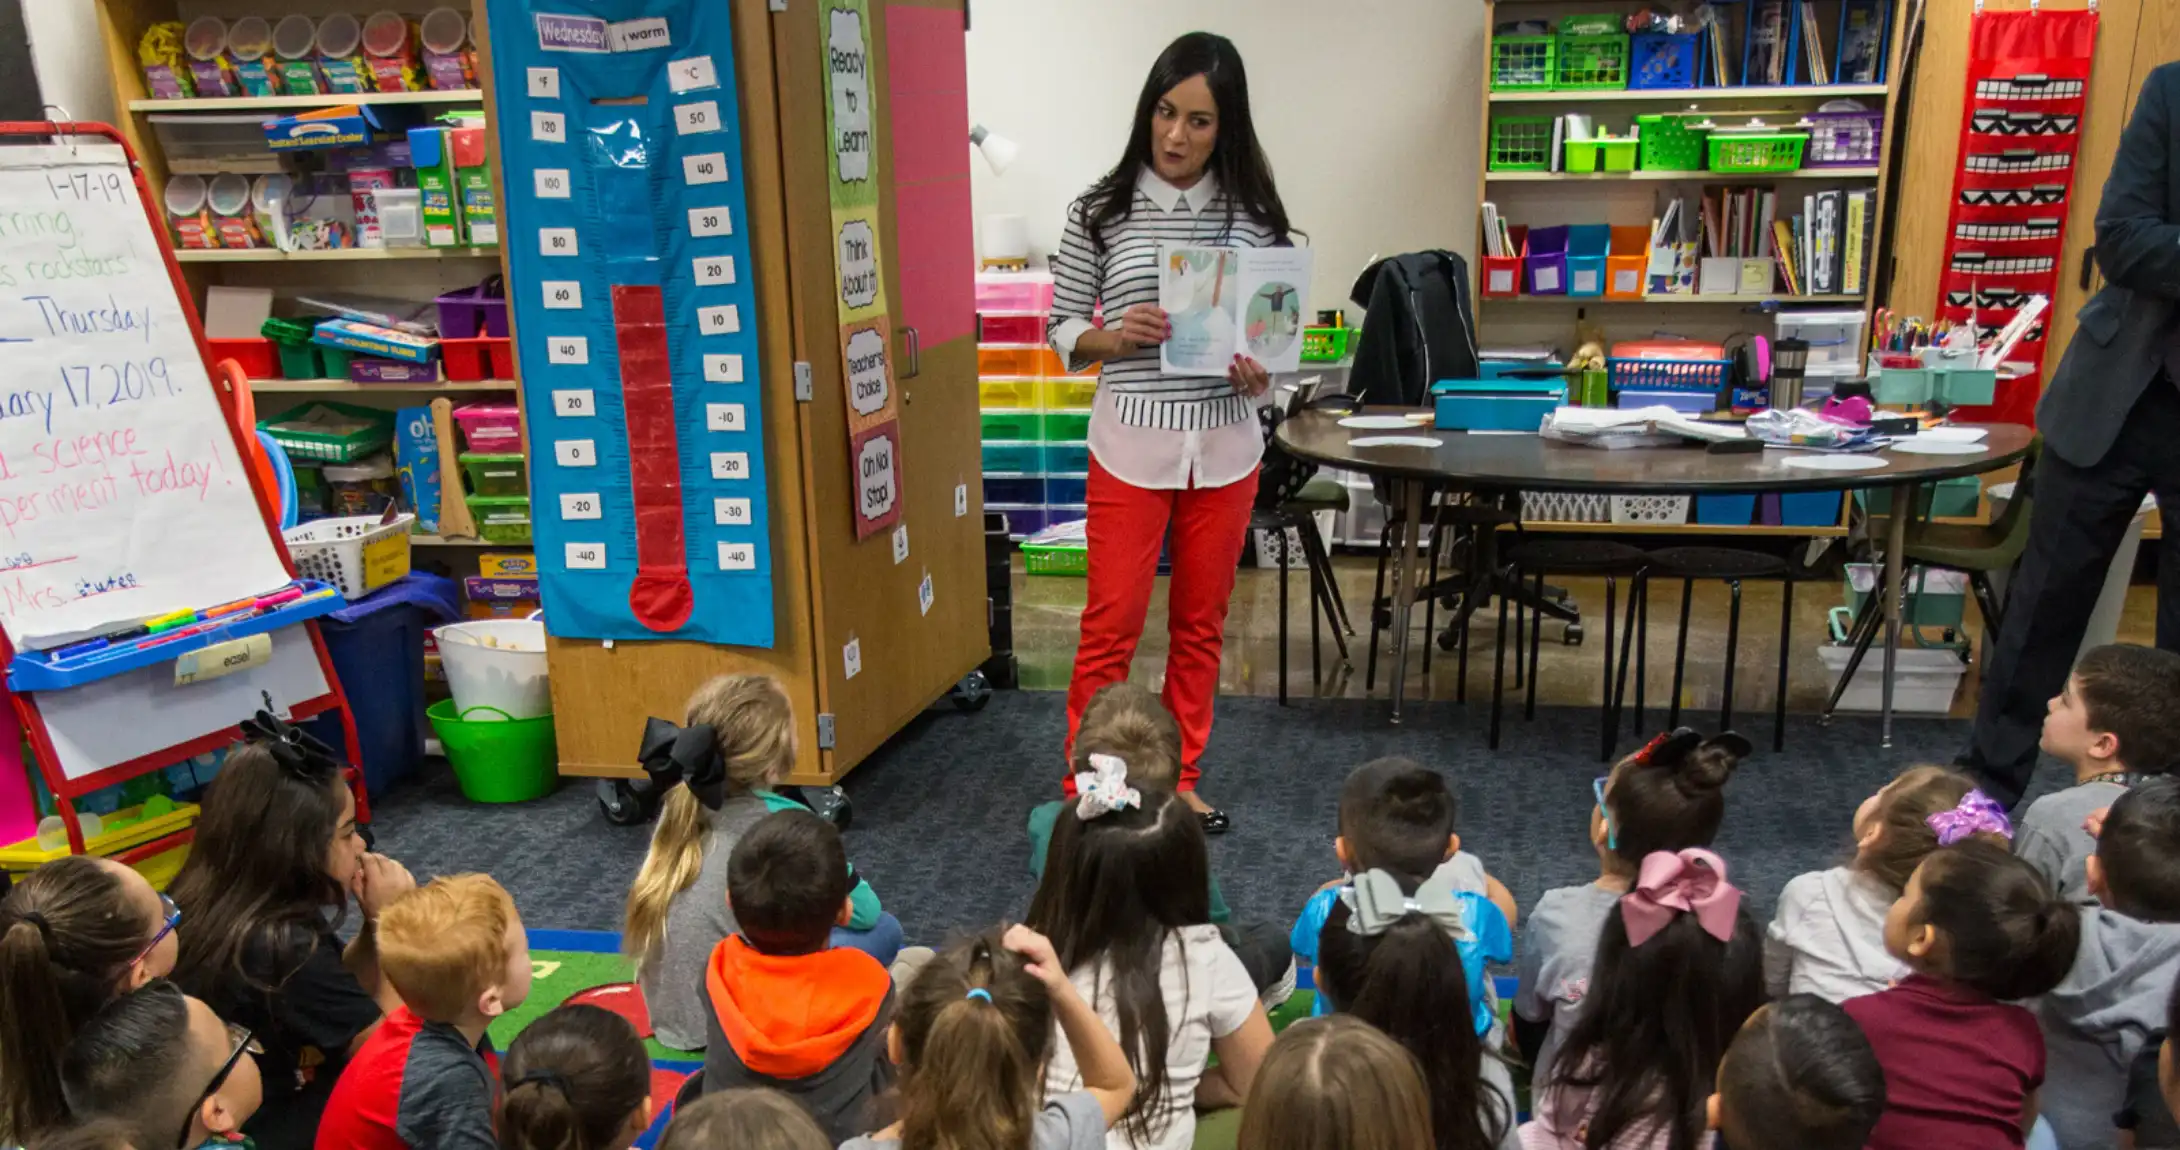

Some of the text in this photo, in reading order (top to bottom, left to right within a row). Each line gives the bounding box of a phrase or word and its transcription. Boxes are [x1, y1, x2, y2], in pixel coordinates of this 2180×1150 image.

[542, 20, 666, 47] Wednesday warm
[831, 47, 865, 80] Ready
[685, 66, 699, 80] °C
[845, 88, 858, 113] to
[690, 112, 705, 125] 50
[541, 120, 557, 133] 120
[268, 132, 364, 149] Instant Learning Center
[838, 127, 869, 153] Learn
[697, 163, 713, 176] 40
[46, 173, 127, 204] 1-17-19
[544, 177, 560, 190] 100
[702, 216, 718, 229] 30
[552, 236, 566, 249] 80
[845, 238, 869, 262] Think
[25, 239, 137, 280] rockstars!
[706, 265, 722, 278] 20
[842, 272, 868, 296] About
[555, 288, 570, 301] 60
[712, 315, 725, 327] 10
[560, 345, 575, 357] 40
[720, 363, 728, 374] 0
[848, 352, 884, 375] Teacher's
[857, 379, 881, 400] Choice
[567, 398, 582, 409] 20
[718, 412, 734, 423] -10
[33, 428, 148, 474] science
[571, 448, 579, 459] 0
[721, 461, 739, 472] -20
[863, 449, 889, 478] Oh No!
[130, 439, 232, 502] today!
[866, 480, 889, 508] Stop!
[572, 501, 590, 512] -20
[724, 506, 742, 518] -30
[576, 551, 595, 562] -40
[727, 552, 746, 562] -40
[3, 576, 68, 617] Mrs.
[223, 643, 251, 668] easel
